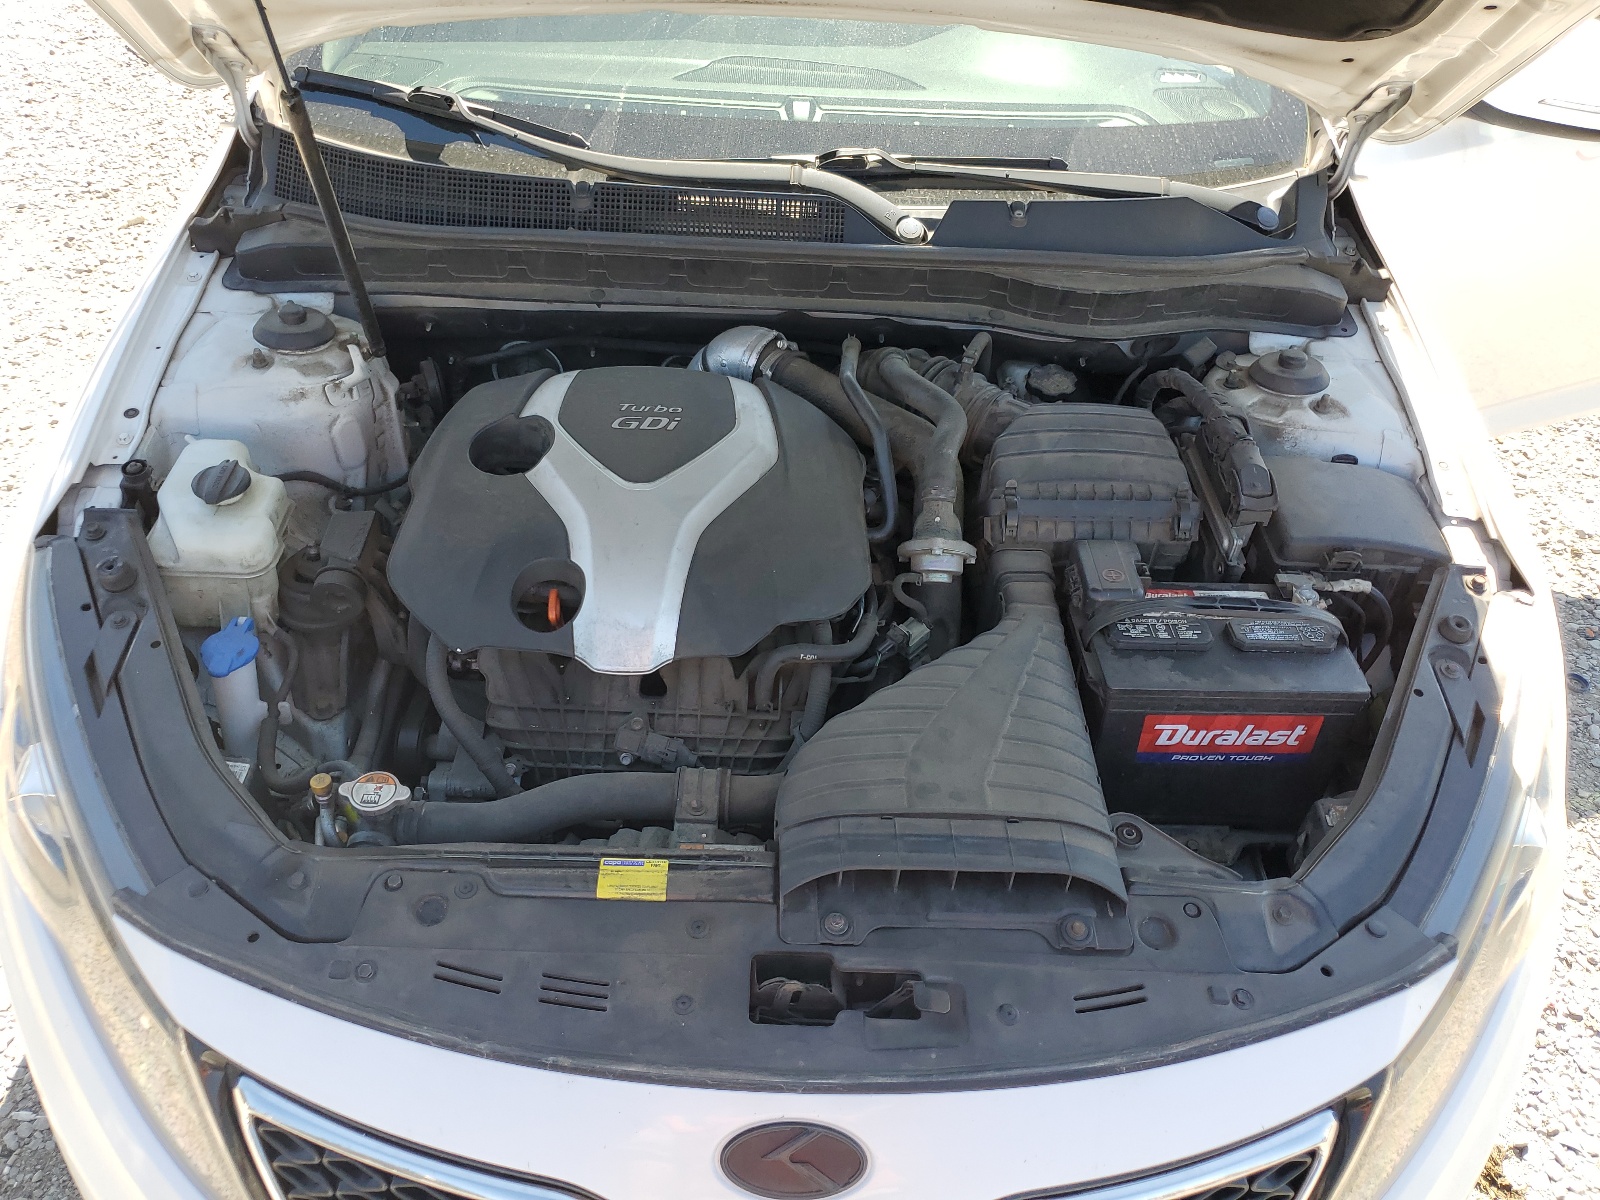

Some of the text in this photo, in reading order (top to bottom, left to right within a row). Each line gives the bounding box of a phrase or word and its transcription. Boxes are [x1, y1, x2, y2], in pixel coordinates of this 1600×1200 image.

[619, 403, 683, 413] Turbo
[611, 416, 681, 430] GDi
[1154, 724, 1307, 746] Duralast
